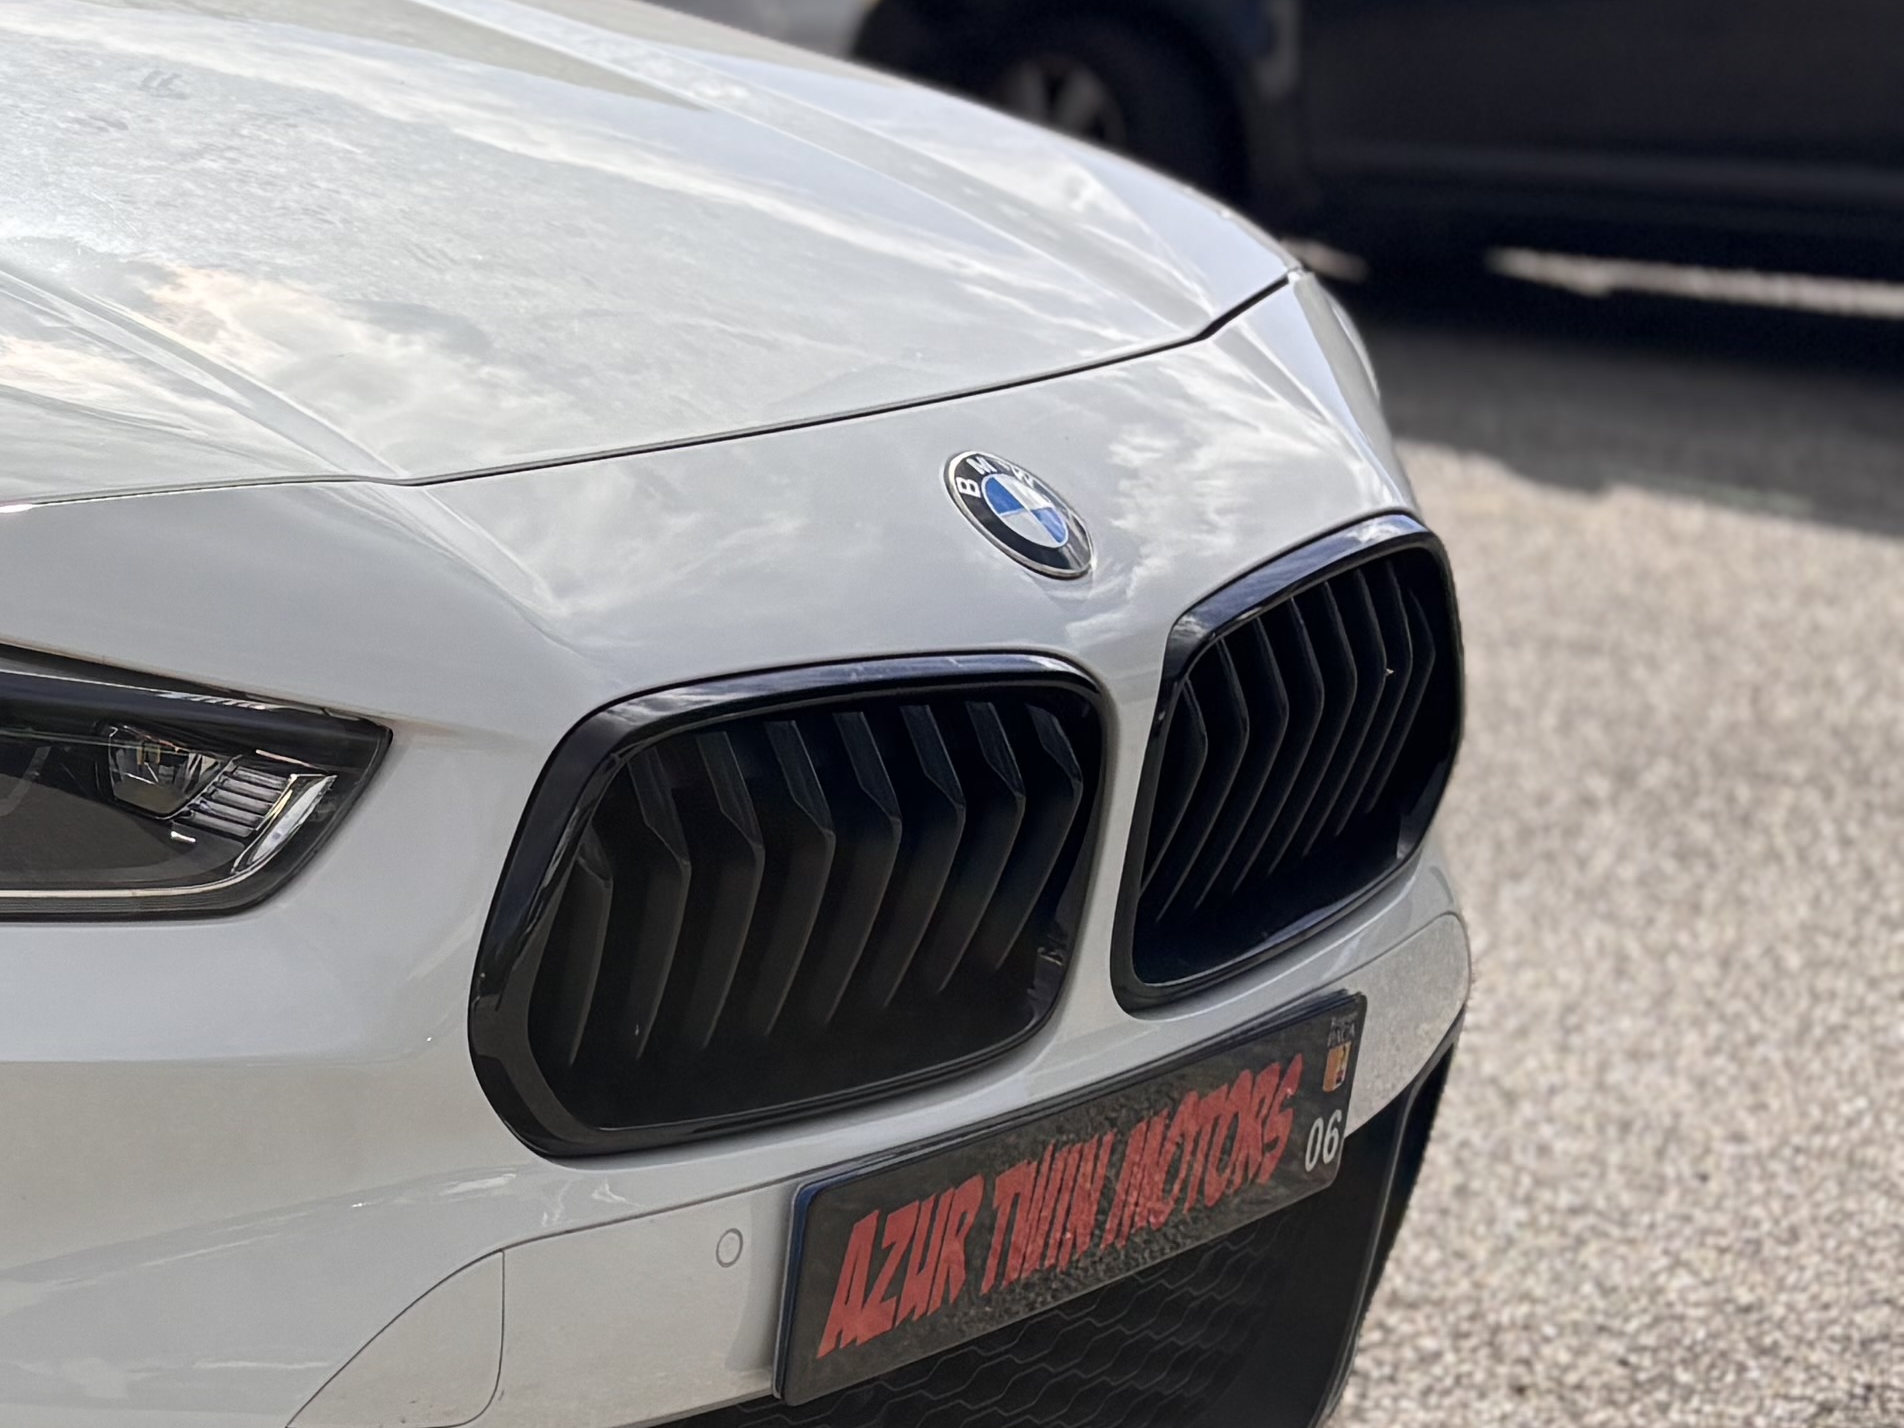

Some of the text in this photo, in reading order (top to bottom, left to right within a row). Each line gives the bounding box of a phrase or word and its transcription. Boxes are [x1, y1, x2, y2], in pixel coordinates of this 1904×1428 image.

[956, 456, 1034, 499] BMW
[1305, 1109, 1342, 1172] 06
[817, 1052, 1303, 1359] AZUR TWIN MOTORS
